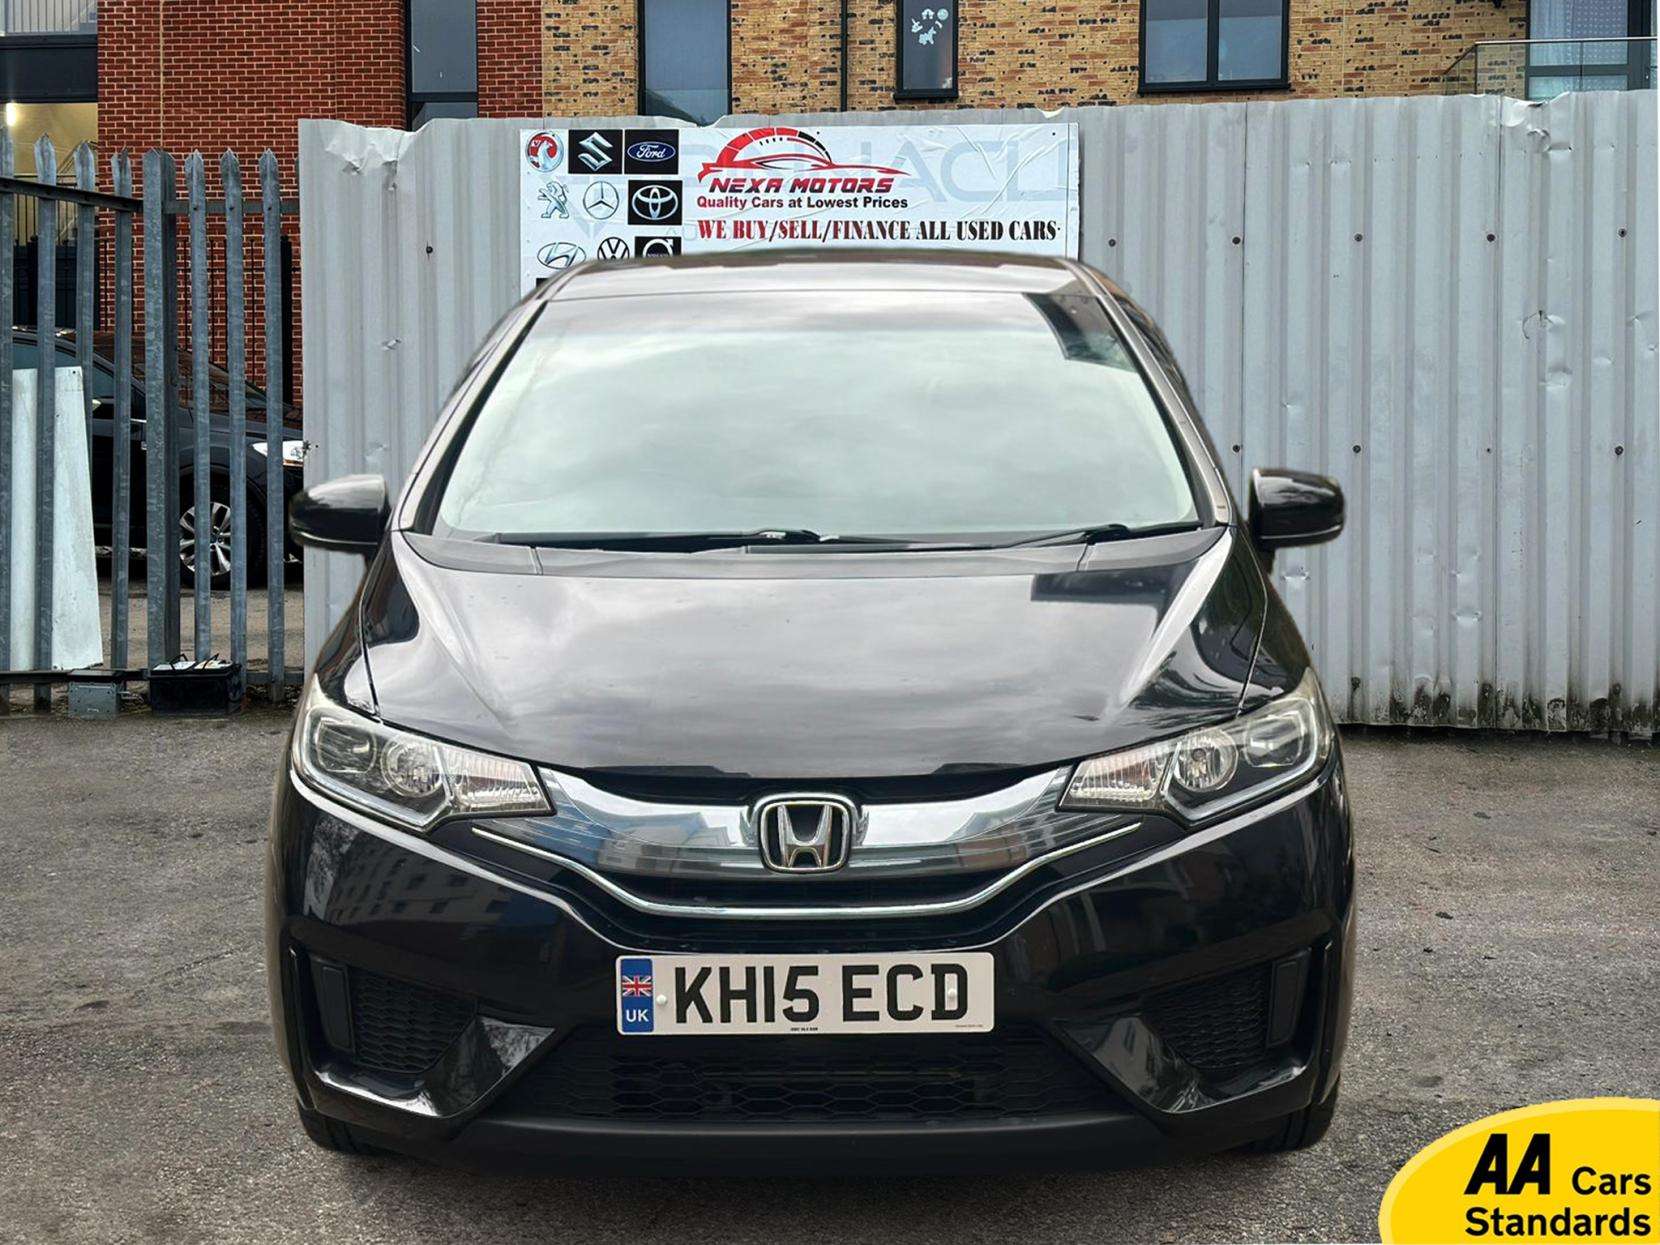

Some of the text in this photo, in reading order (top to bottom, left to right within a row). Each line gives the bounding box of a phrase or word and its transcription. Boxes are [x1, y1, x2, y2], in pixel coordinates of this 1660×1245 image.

[636, 144, 666, 159] Ford
[709, 178, 894, 193] NEXA MOTORS
[697, 196, 908, 210] Quality Cars at Lowest Prices
[697, 220, 727, 239] WE
[916, 220, 951, 240] ALL
[956, 220, 1003, 241] USED
[1008, 220, 1057, 241] CARS
[674, 963, 968, 1023] KH15 ECD
[625, 1009, 649, 1023] UK
